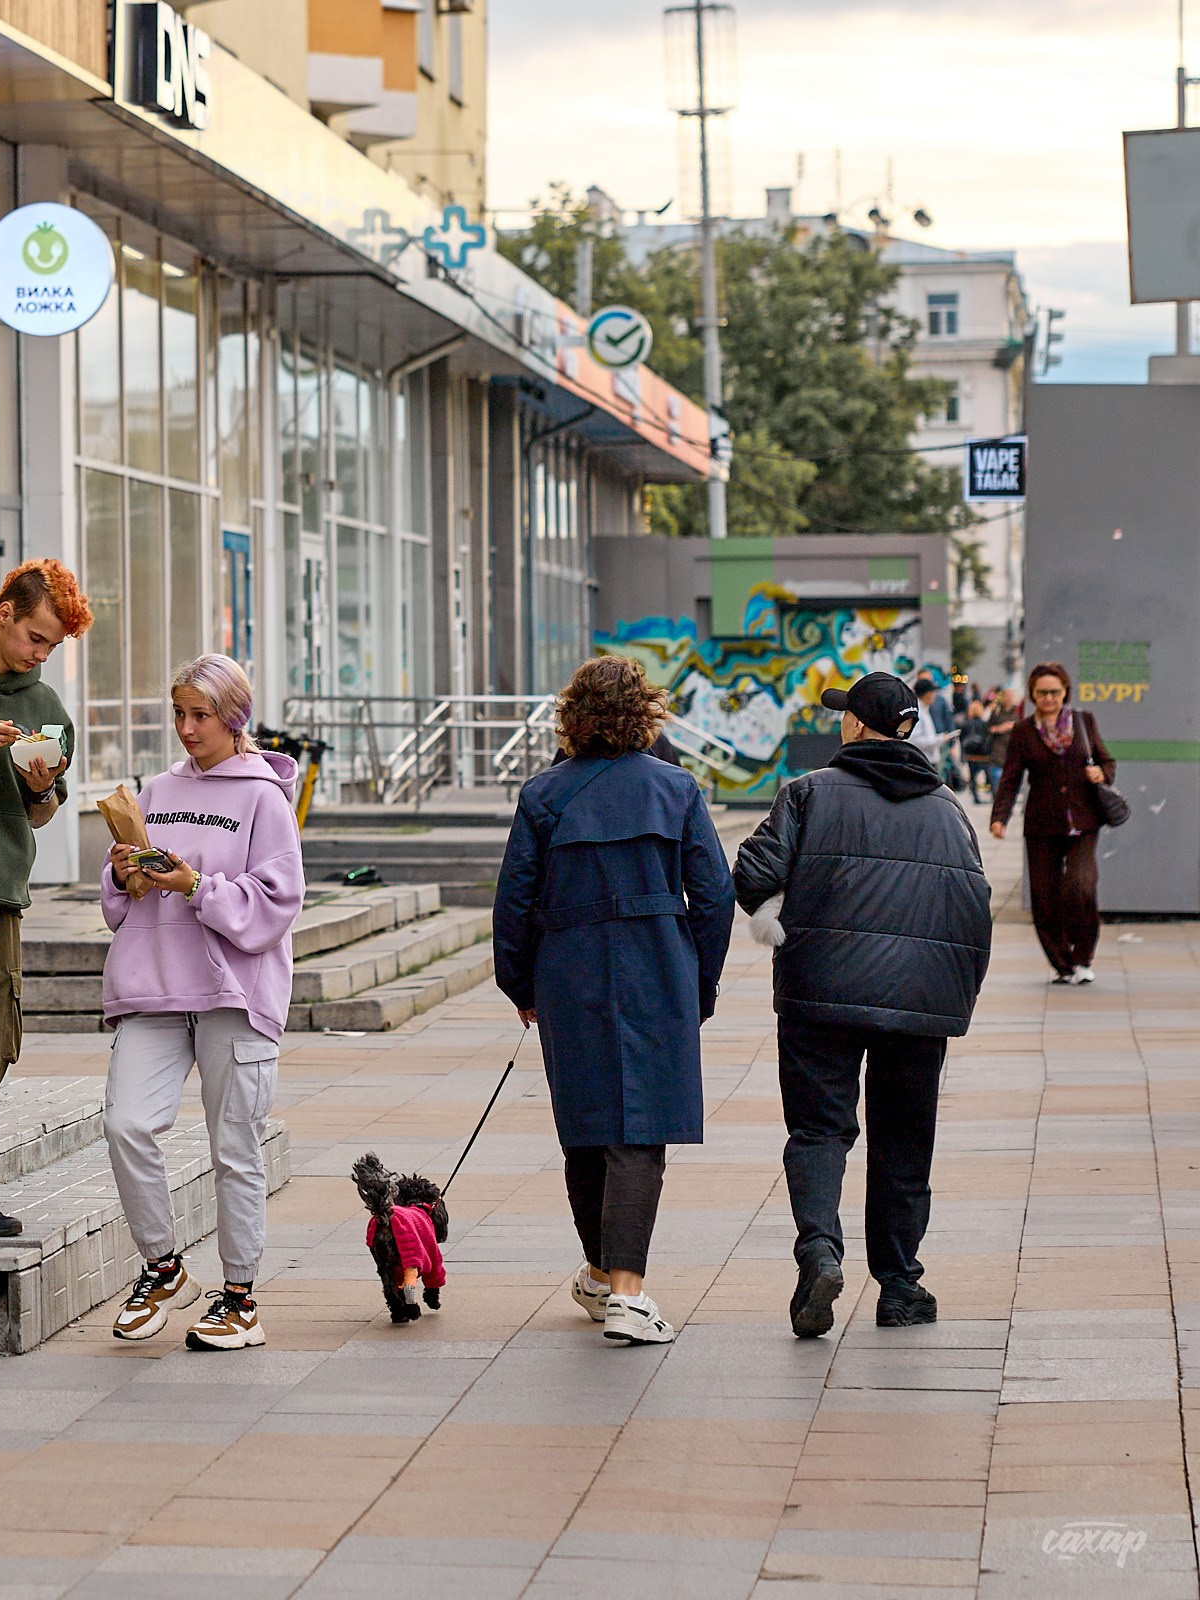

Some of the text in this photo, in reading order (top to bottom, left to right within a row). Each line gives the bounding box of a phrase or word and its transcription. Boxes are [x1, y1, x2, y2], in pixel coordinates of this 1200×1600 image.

[157, 0, 211, 130] DNS
[16, 287, 74, 298] ВИЛКА
[15, 302, 76, 314] ЛОЖКА
[973, 447, 1020, 472] VAPE
[974, 472, 1020, 491] ТАБАК
[1079, 682, 1149, 703] БУРГ
